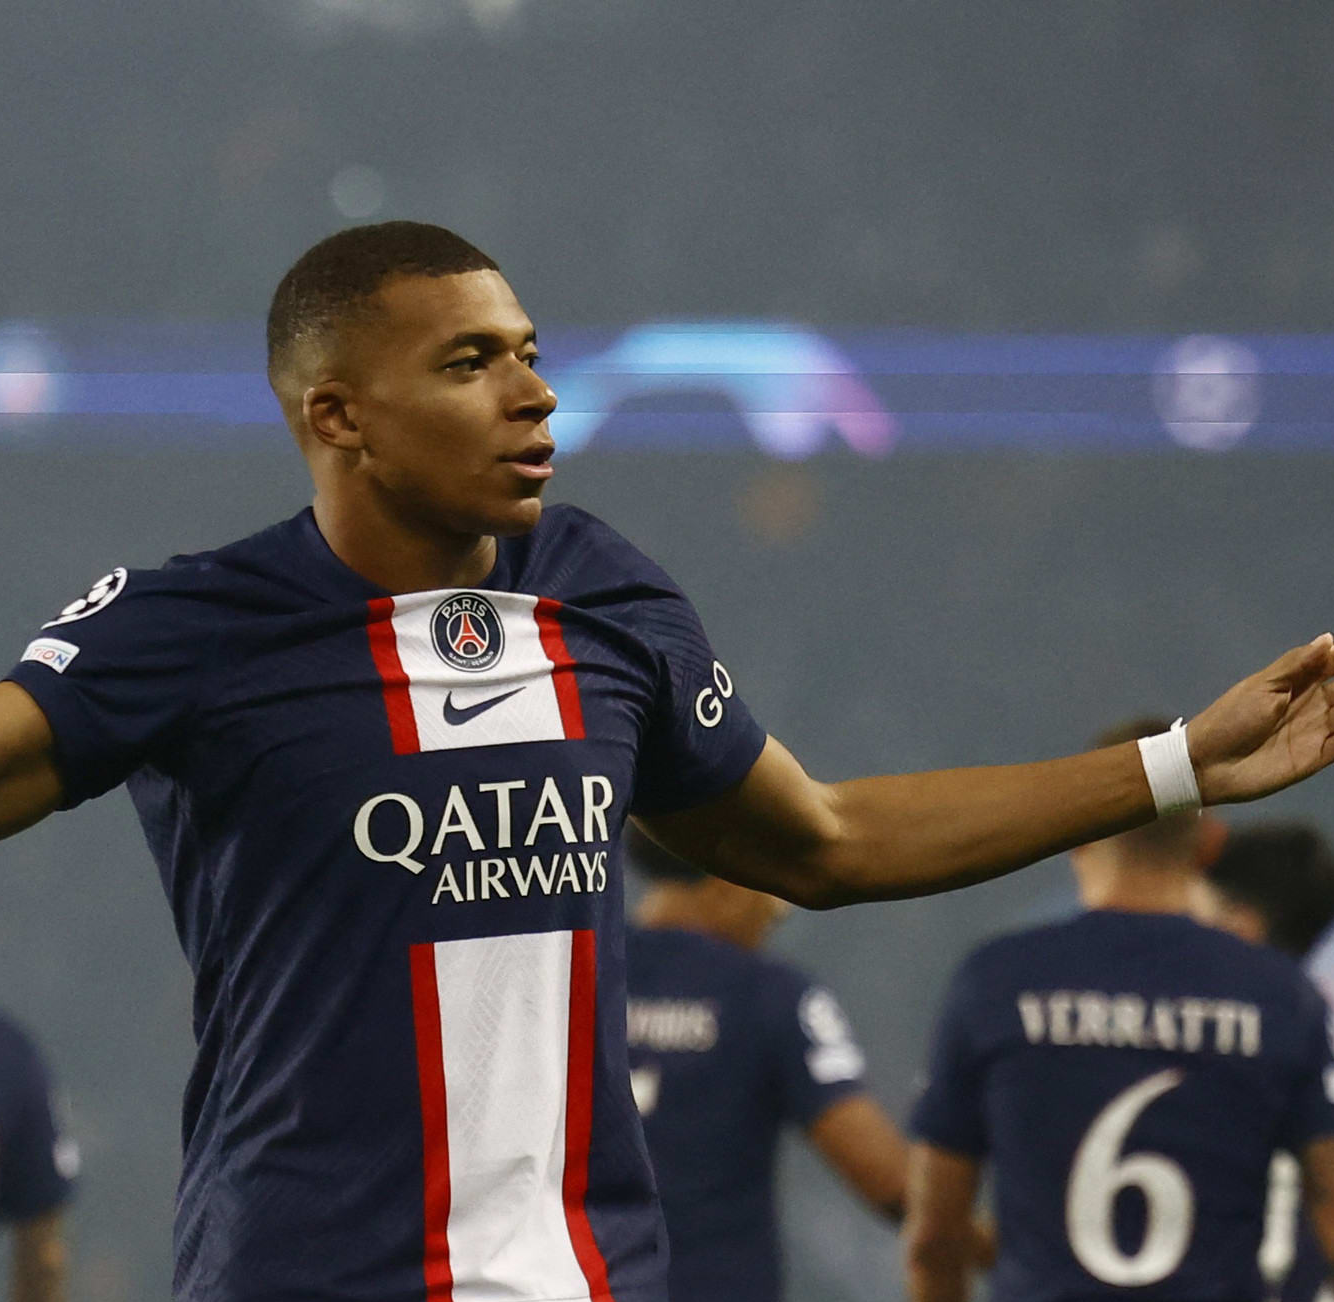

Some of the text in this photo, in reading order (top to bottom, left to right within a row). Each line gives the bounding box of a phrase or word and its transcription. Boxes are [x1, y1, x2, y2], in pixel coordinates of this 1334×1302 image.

[441, 599, 488, 619] PARIS
[353, 775, 614, 874] QATAR
[431, 850, 607, 904] AIRWAYS
[1017, 989, 1263, 1058] VERRATTI
[1066, 1064, 1196, 1289] 6
